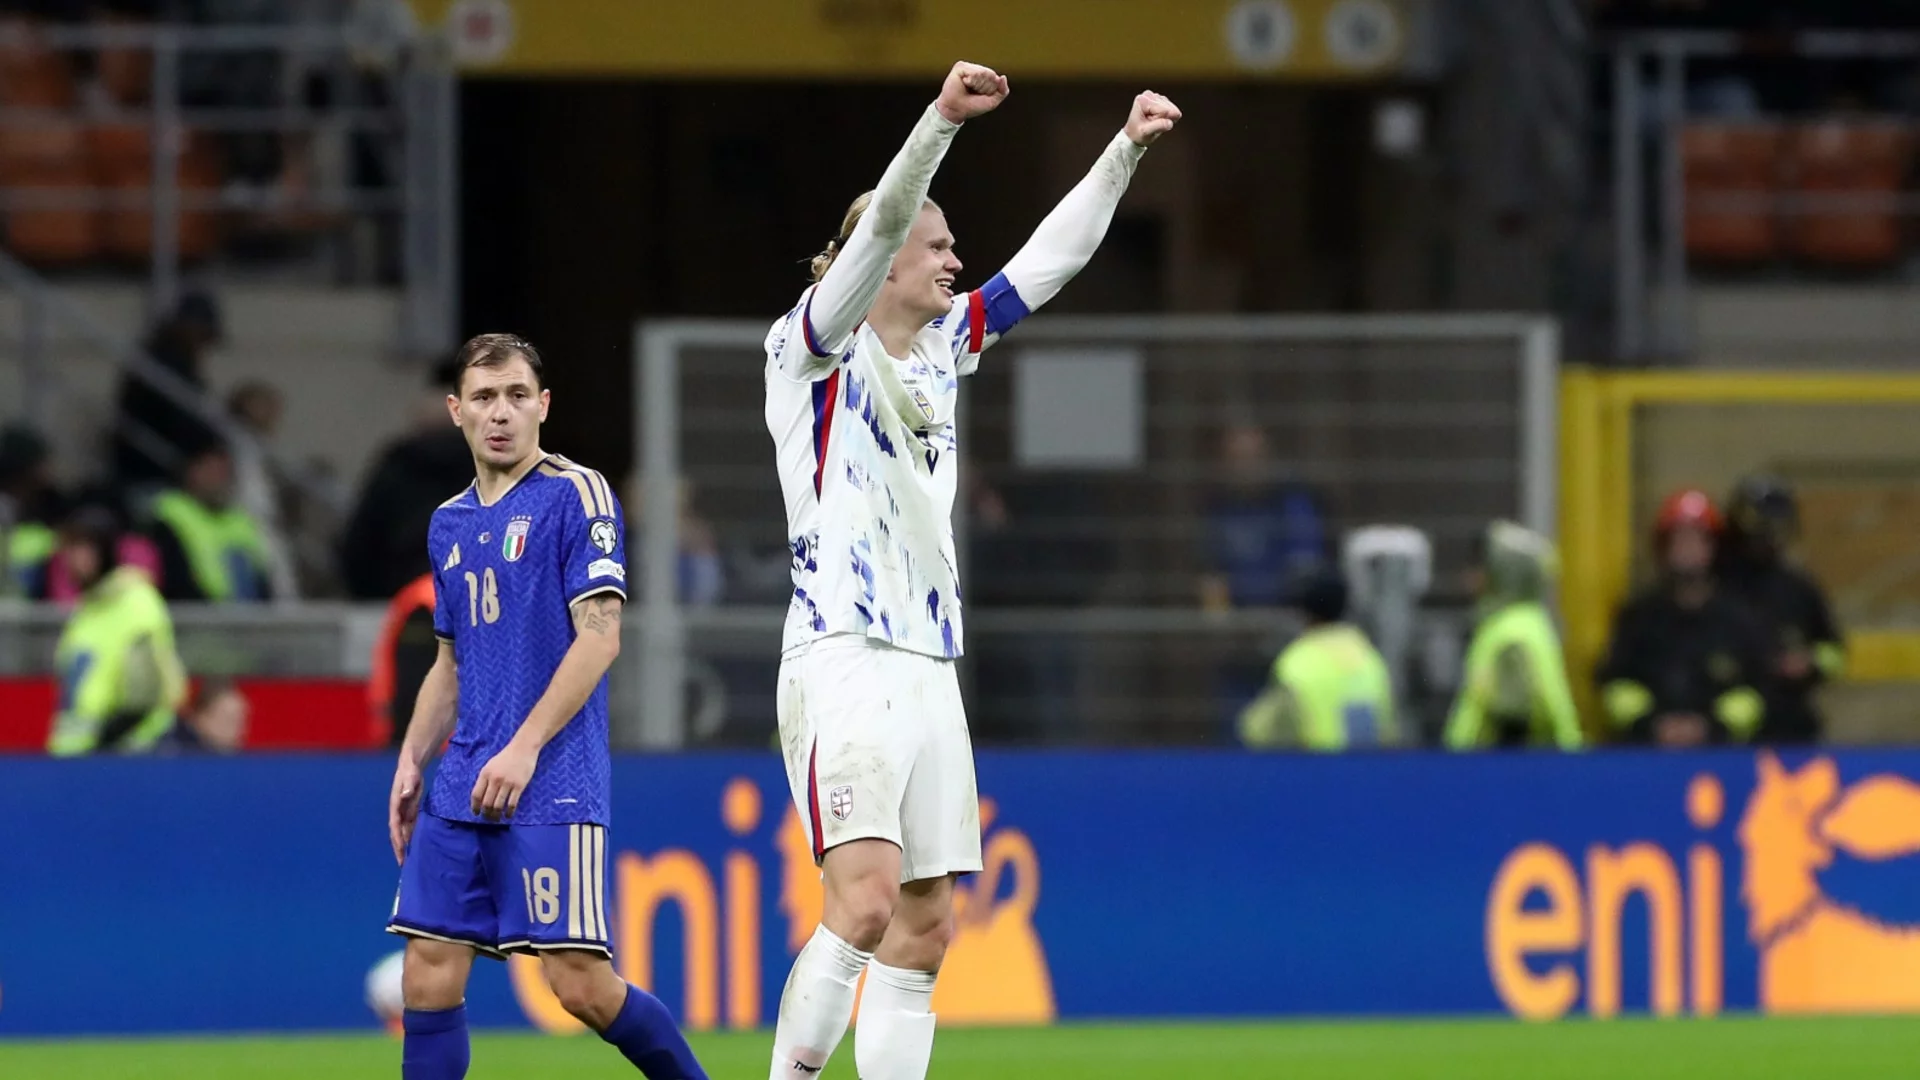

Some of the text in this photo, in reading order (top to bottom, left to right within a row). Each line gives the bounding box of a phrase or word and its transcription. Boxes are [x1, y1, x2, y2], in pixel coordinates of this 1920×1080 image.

[464, 567, 500, 627] 18
[522, 866, 560, 925] 18
[1486, 772, 1725, 1019] eni
